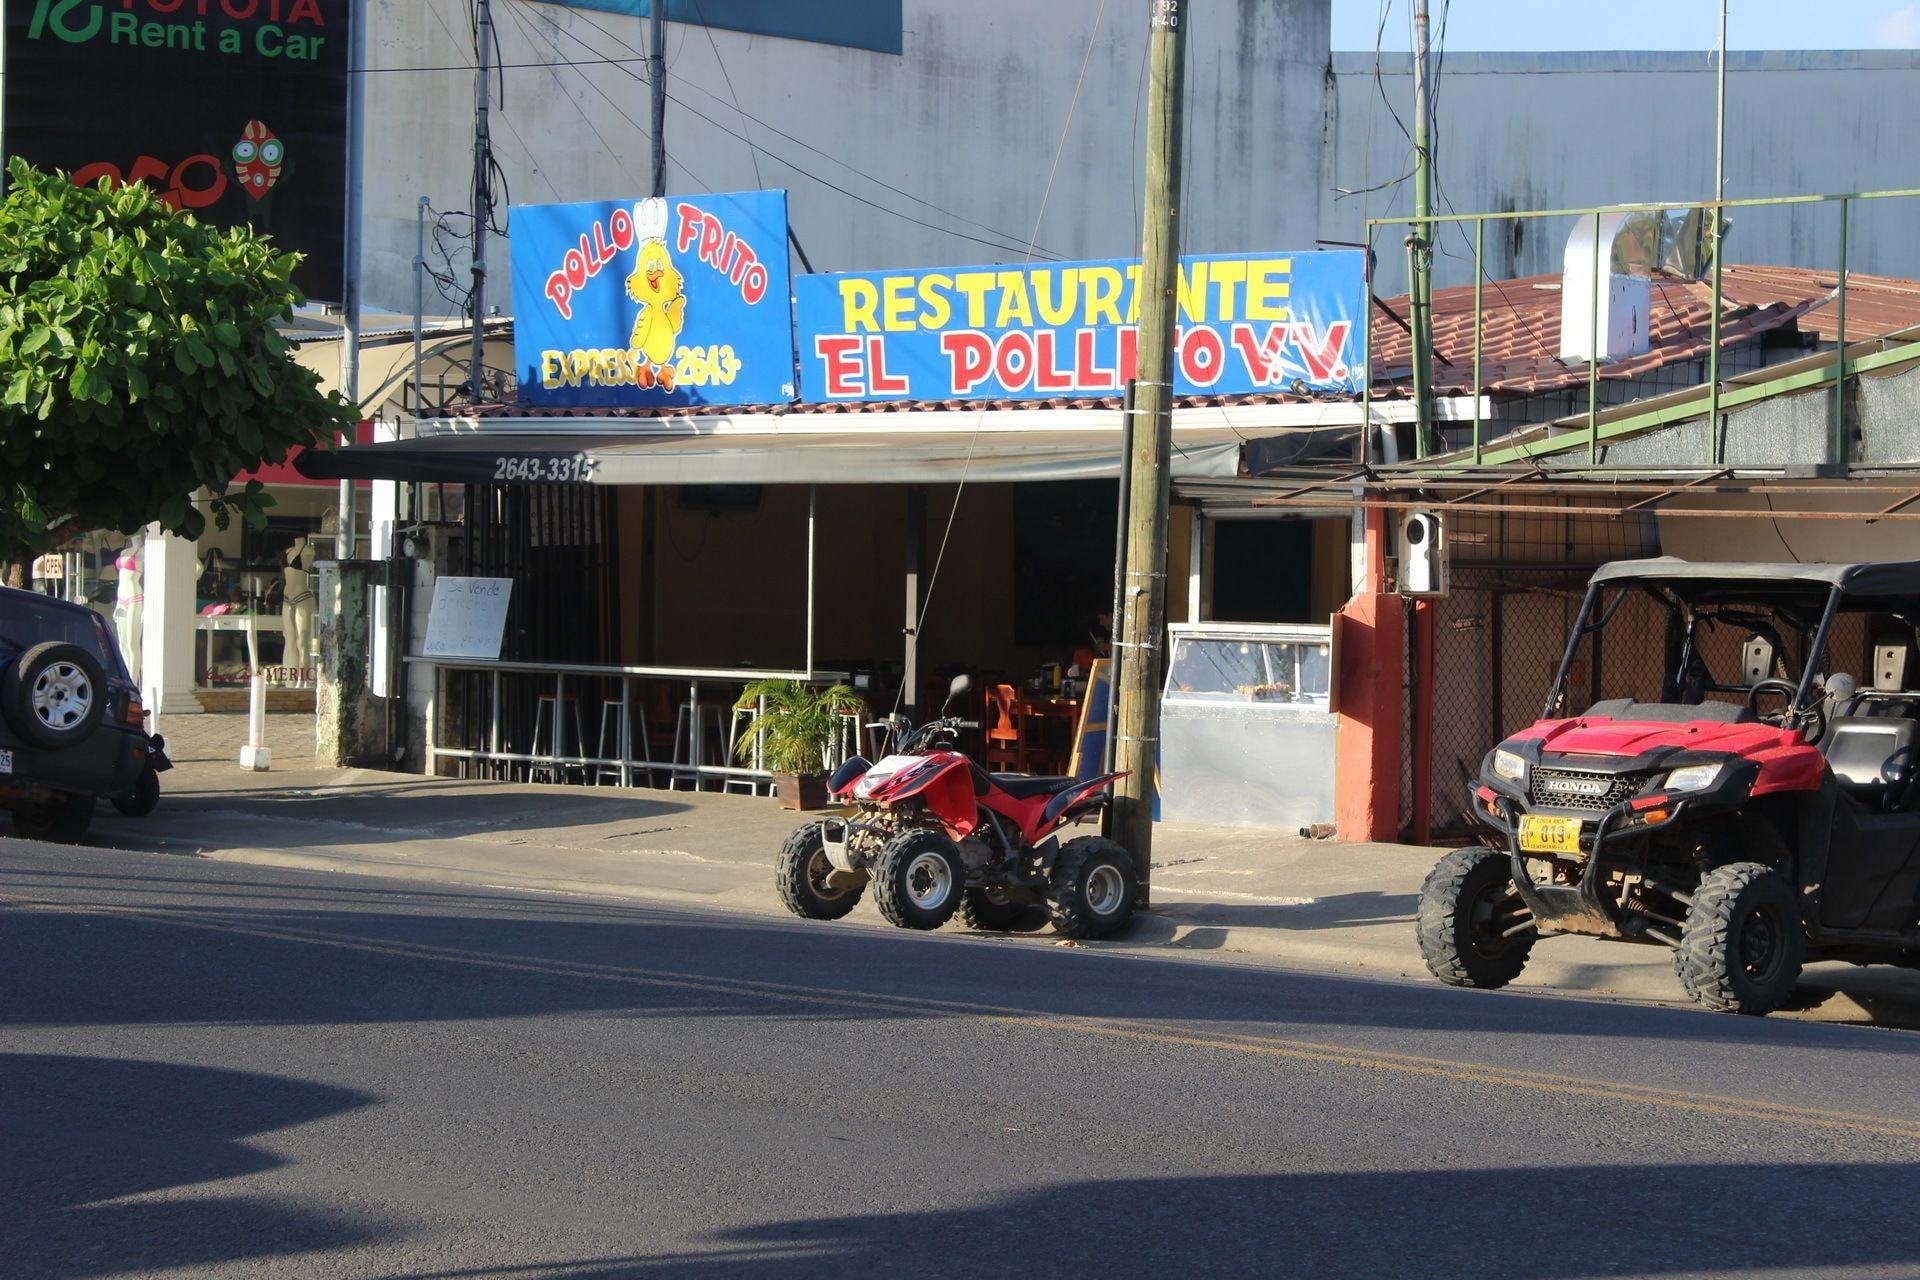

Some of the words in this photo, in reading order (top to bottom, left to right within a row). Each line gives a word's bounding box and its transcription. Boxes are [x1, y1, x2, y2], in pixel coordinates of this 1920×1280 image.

[110, 12, 206, 50] Rent
[218, 28, 241, 54] a
[255, 24, 325, 60] Car
[545, 208, 634, 320] POLLO
[677, 203, 767, 304] FRITO
[541, 348, 639, 389] EXPRESS
[814, 333, 909, 397] EL
[941, 325, 1225, 394] POLLO
[494, 457, 595, 482] 2643-3315
[45, 558, 62, 574] OPEN
[1547, 781, 1602, 793] HONDA
